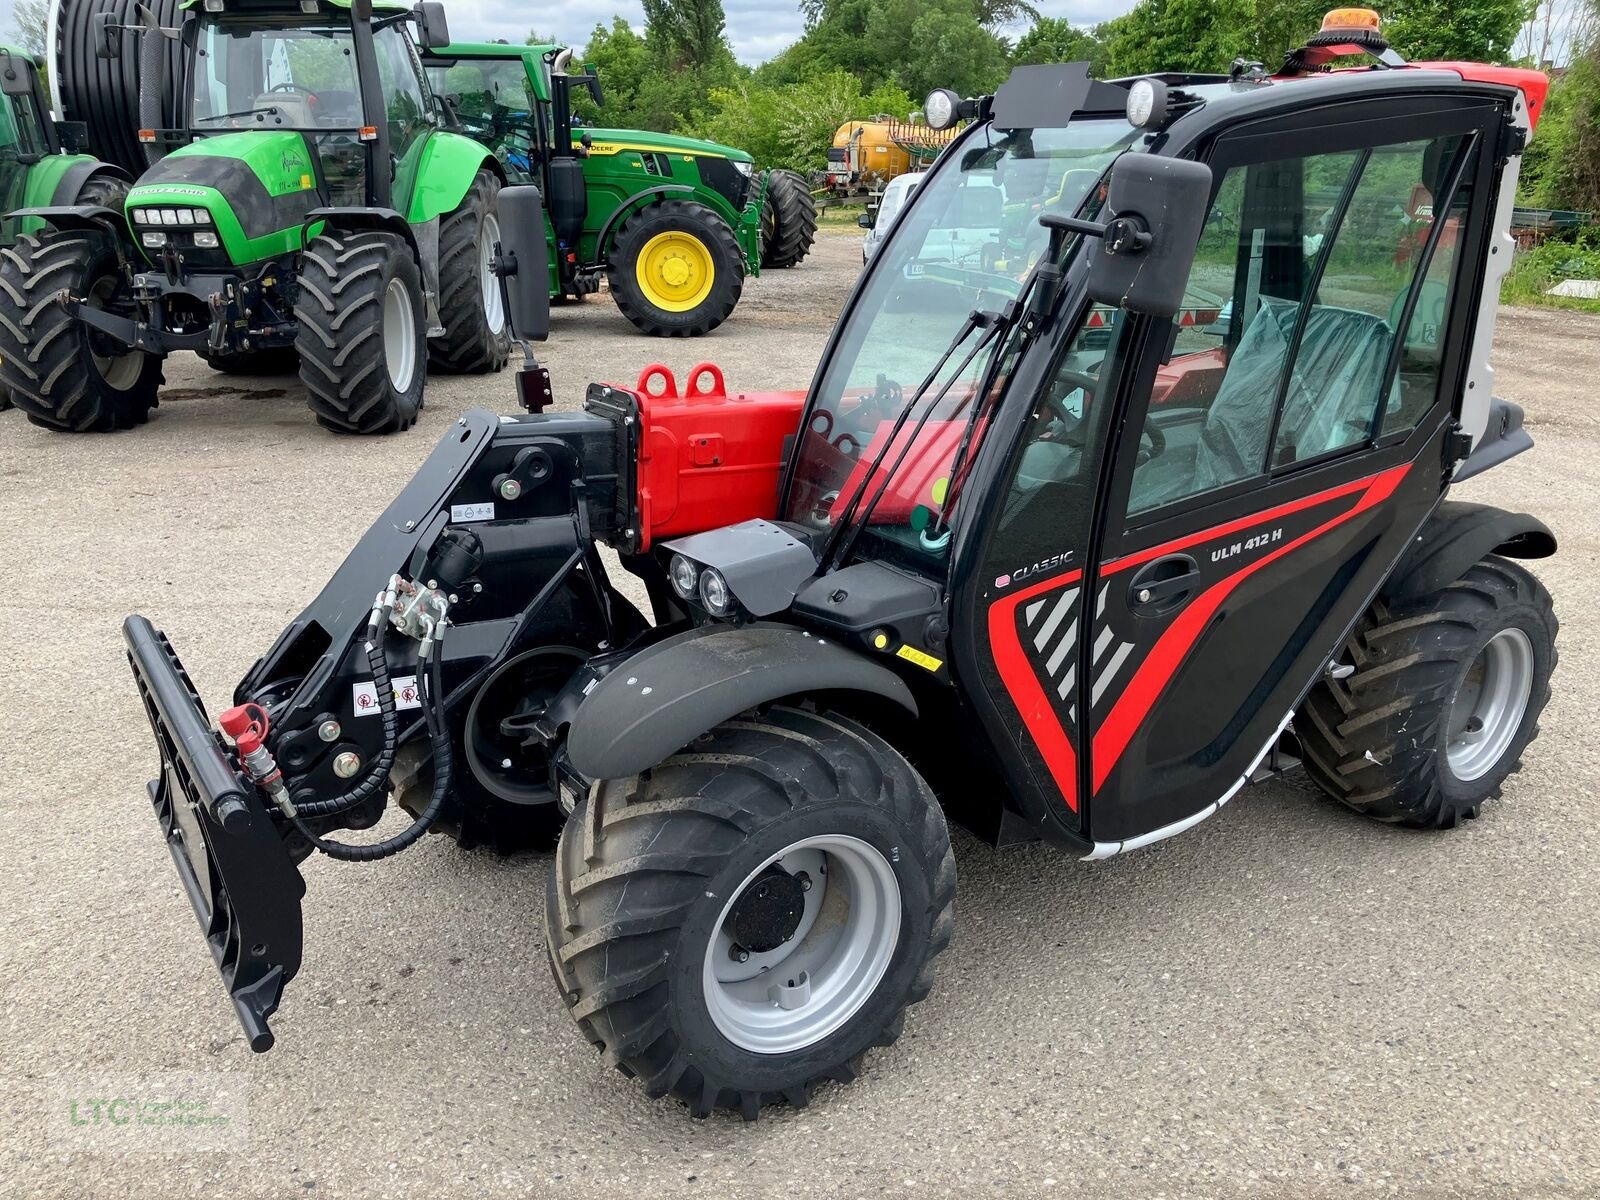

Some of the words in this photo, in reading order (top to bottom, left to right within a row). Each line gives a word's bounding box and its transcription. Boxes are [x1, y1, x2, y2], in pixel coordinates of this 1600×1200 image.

[1211, 542, 1242, 562] ULM
[1244, 533, 1270, 550] 412
[1271, 528, 1283, 542] H
[1012, 550, 1074, 582] CLASSIC
